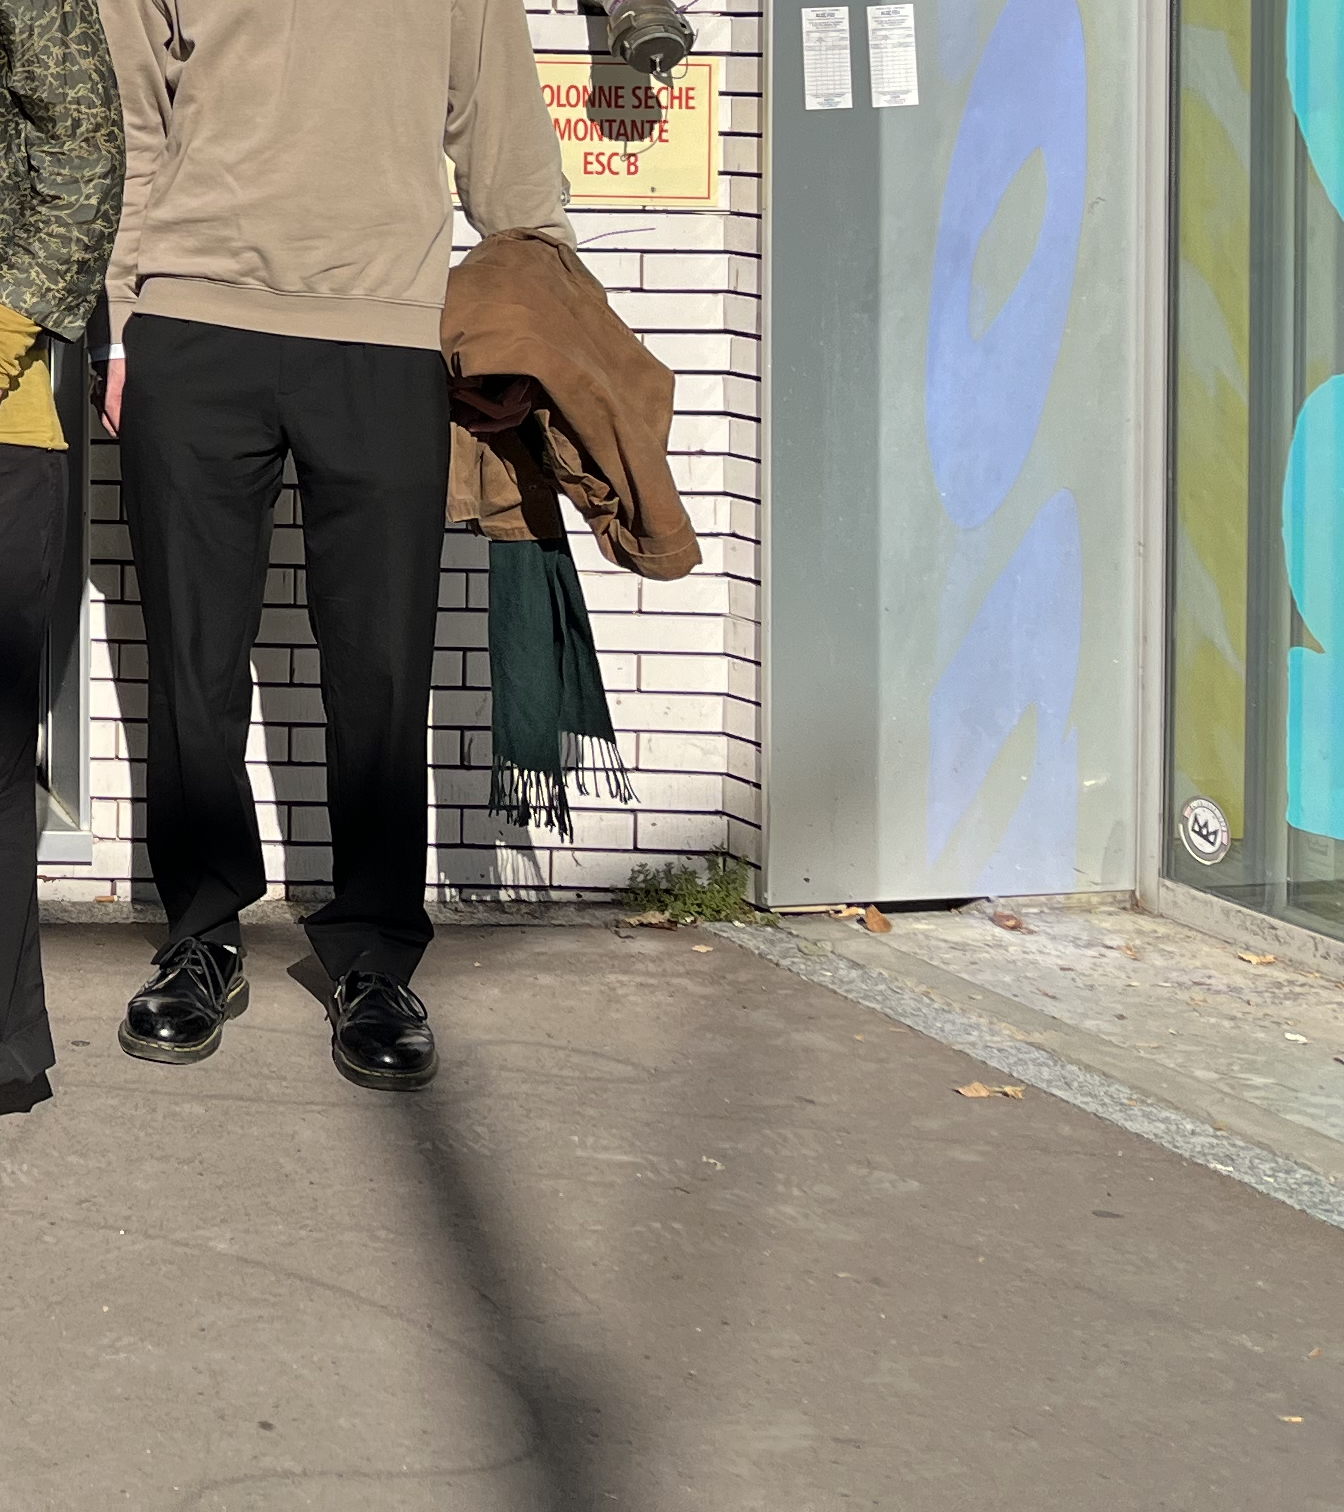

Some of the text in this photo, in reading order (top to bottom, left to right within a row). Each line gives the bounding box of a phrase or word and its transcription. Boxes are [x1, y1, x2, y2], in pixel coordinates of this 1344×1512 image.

[541, 84, 696, 110] OLONNE SECHE
[553, 118, 670, 143] MONTANTE
[583, 152, 639, 176] ESC B
